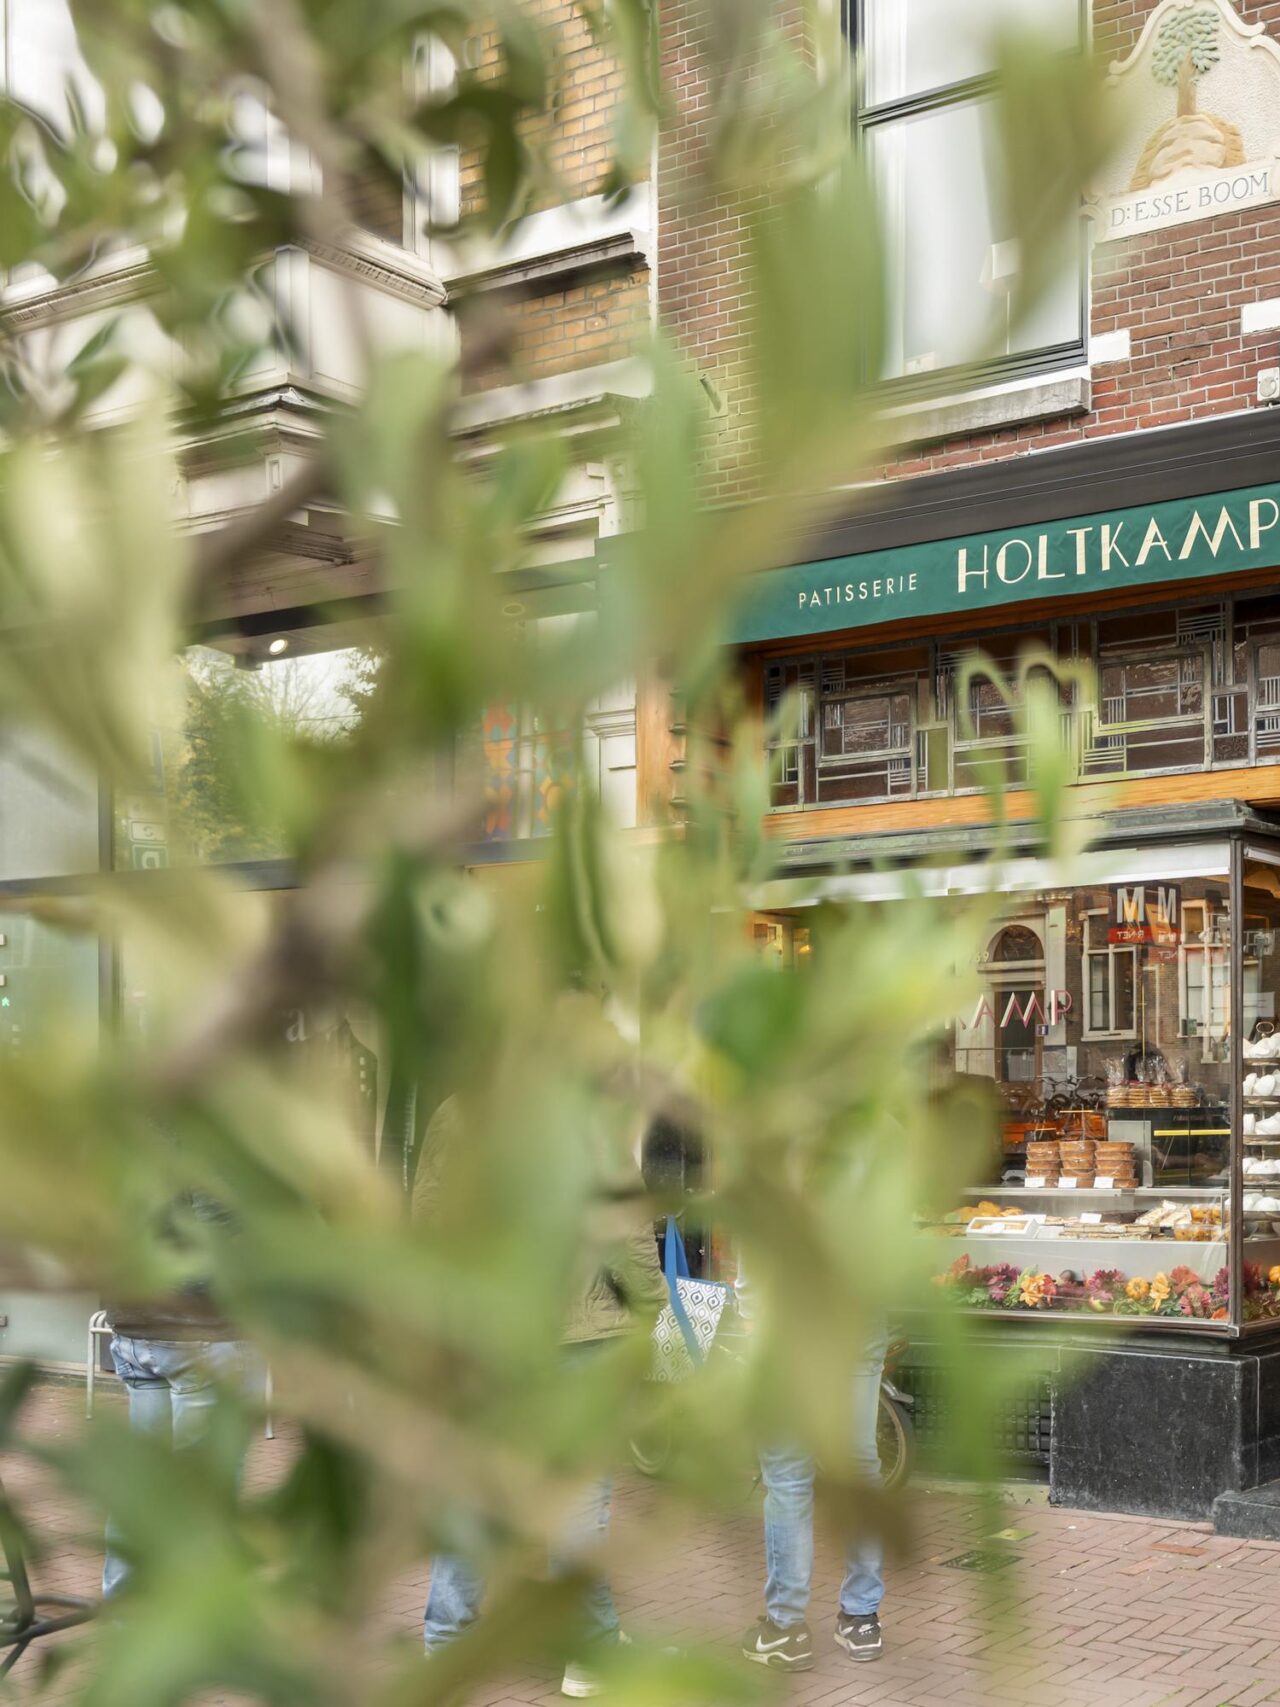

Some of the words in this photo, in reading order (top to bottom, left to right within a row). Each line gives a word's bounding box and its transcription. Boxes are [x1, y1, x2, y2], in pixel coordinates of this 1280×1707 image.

[1198, 172, 1269, 207] BOOM
[799, 573, 917, 609] PATISSERIE
[958, 498, 1279, 593] HOLTKAMP
